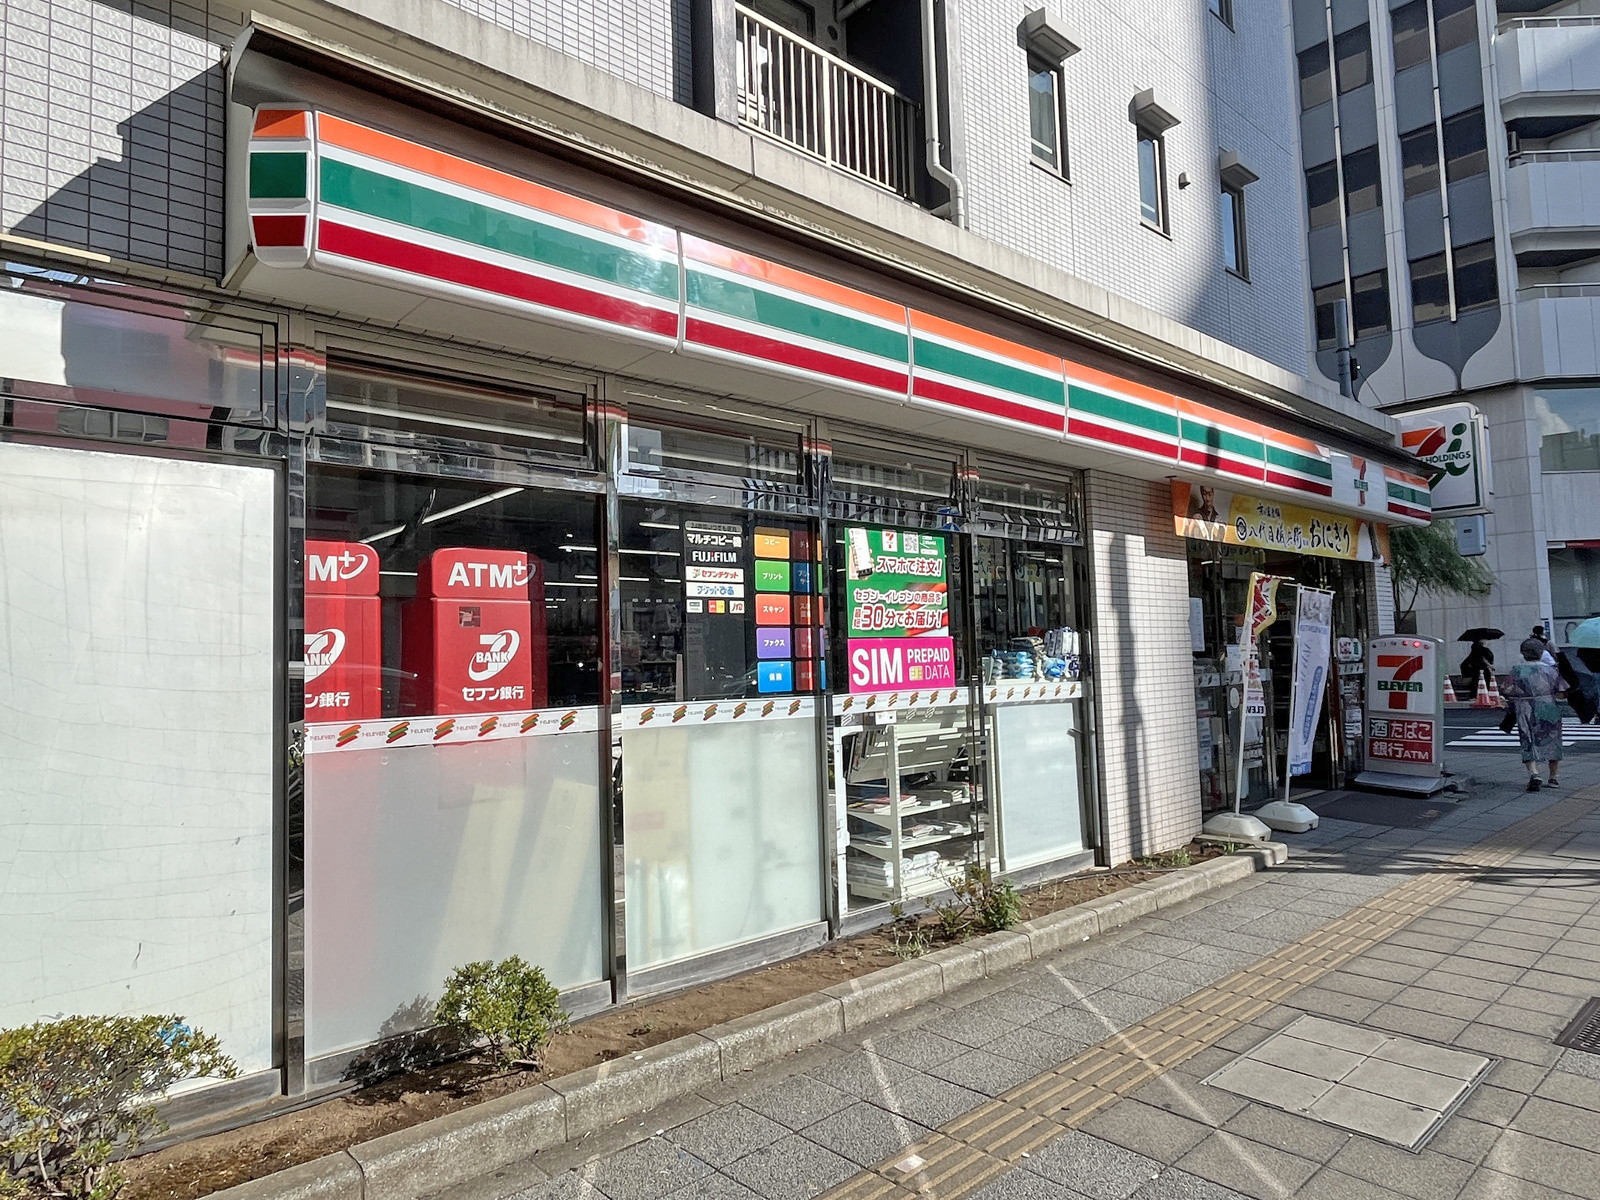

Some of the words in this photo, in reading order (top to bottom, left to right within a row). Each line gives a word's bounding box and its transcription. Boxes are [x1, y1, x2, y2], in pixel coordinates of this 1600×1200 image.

[1426, 451, 1471, 463] HOLDINGS
[687, 534, 742, 547] マルチコピー機
[1310, 519, 1350, 554] おにぎり
[692, 551, 737, 563] FUJIFILM
[764, 639, 785, 647] ファクス
[476, 652, 509, 663] BANK
[907, 648, 950, 663] PREPAID
[852, 648, 903, 686] SIM
[925, 664, 950, 680] DATA
[1377, 655, 1423, 709] 7
[462, 686, 524, 701] セブン銀行
[1371, 720, 1388, 737] 酒
[1390, 722, 1431, 740] たばこ
